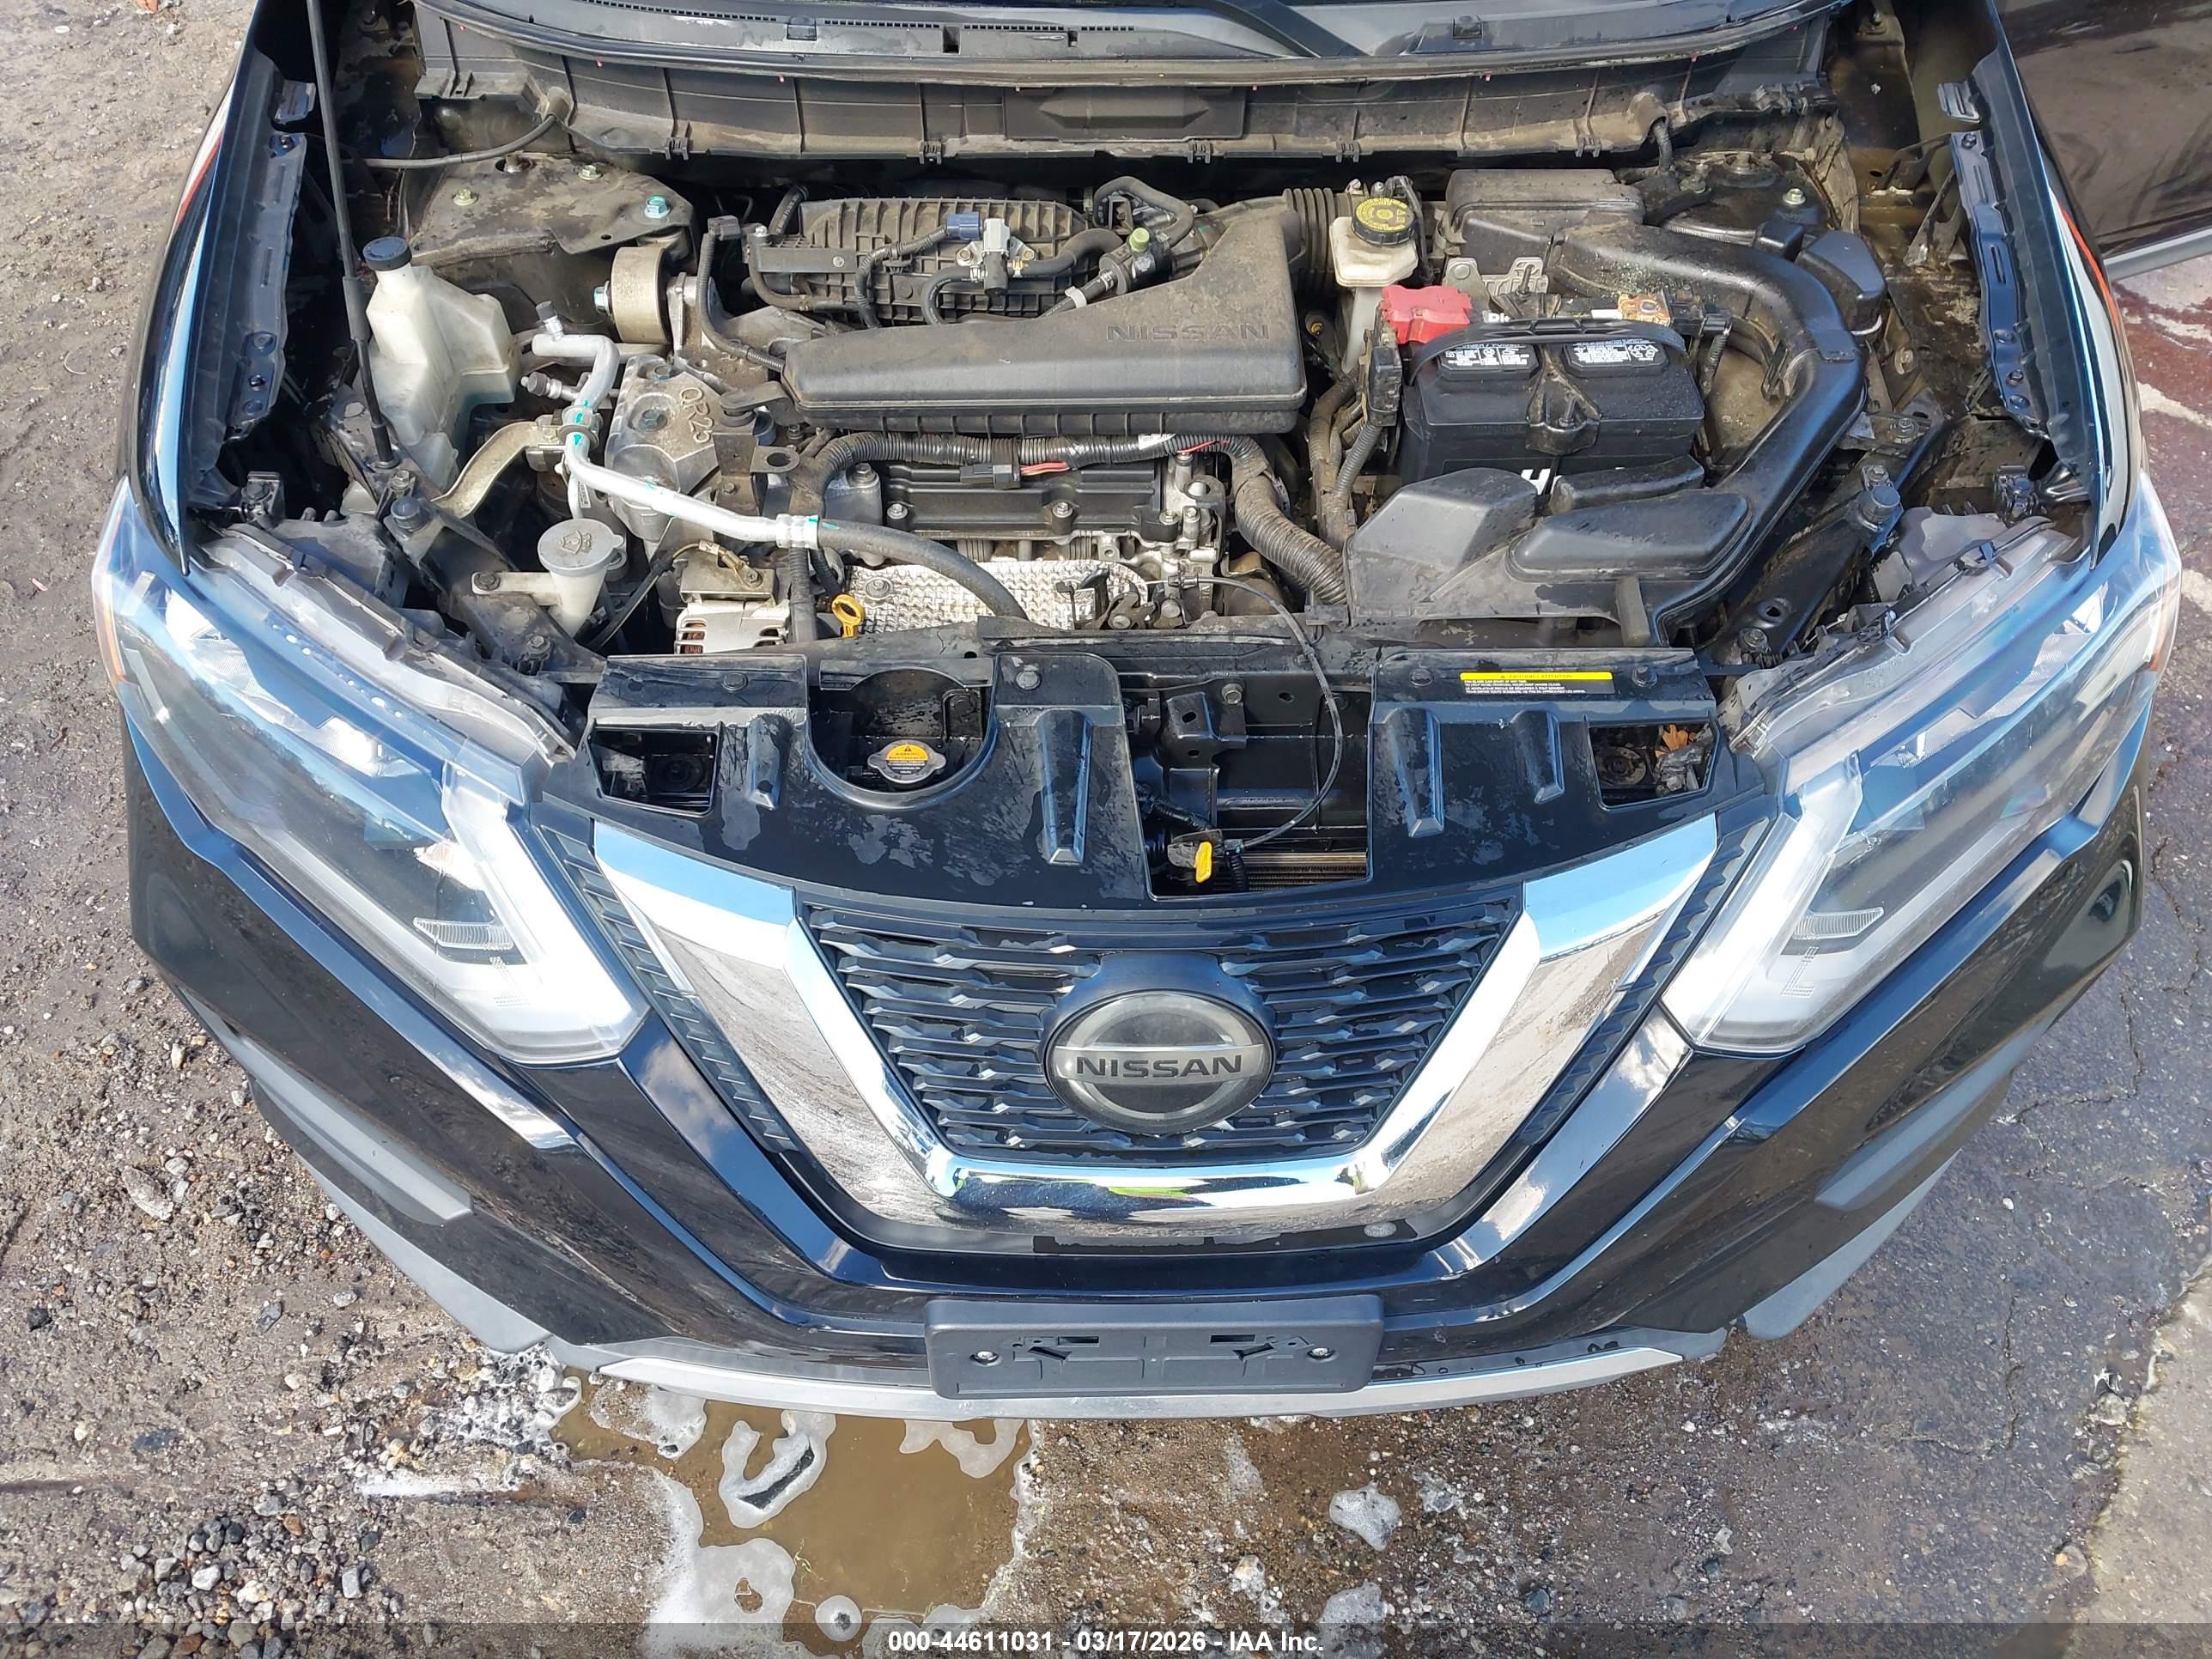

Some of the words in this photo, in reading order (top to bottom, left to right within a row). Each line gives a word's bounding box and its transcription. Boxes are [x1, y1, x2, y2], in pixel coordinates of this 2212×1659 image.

[1106, 323, 1270, 343] NISSAN
[680, 386, 714, 444] QR25
[1076, 1054, 1243, 1079] NISSAN
